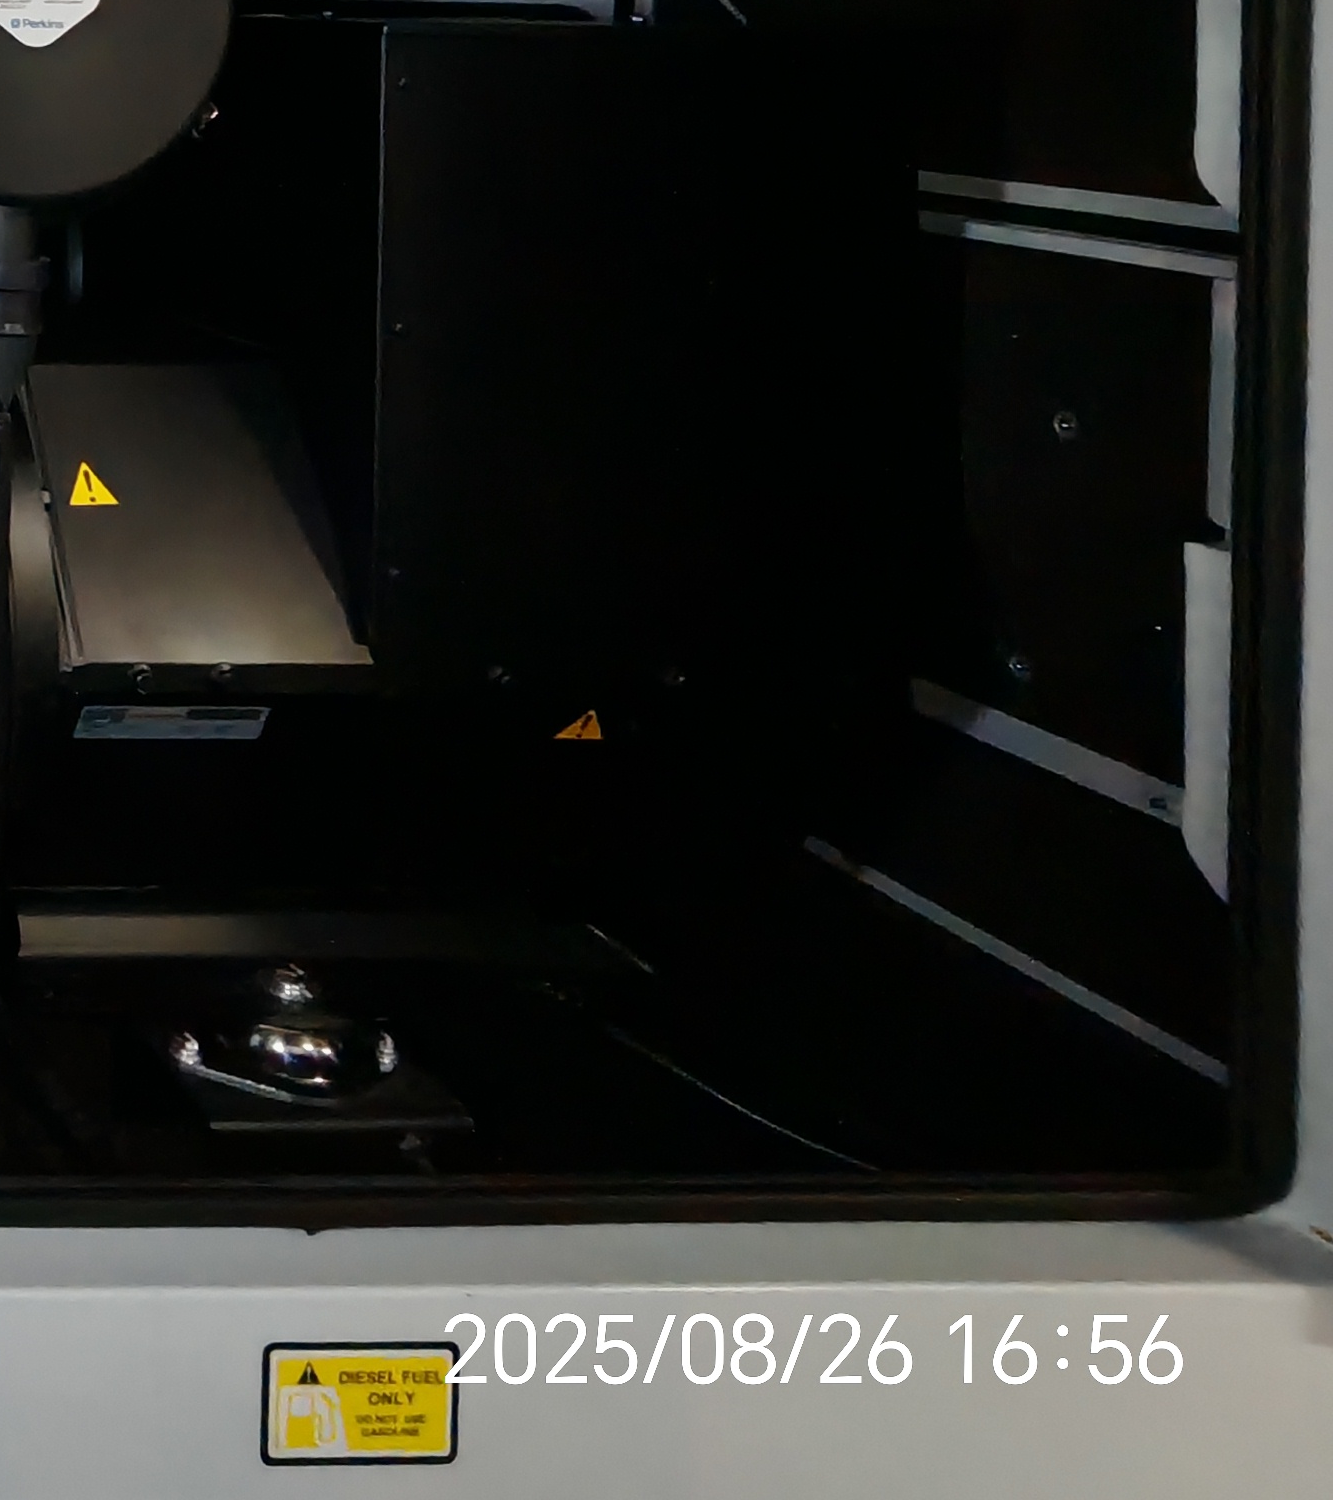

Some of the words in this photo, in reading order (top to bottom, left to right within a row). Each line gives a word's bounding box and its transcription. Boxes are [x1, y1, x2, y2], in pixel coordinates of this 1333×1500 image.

[23, 19, 64, 29] Perkins
[339, 1370, 396, 1384] DIESEL
[401, 1370, 445, 1385] FUEL
[367, 1392, 415, 1406] ONLY
